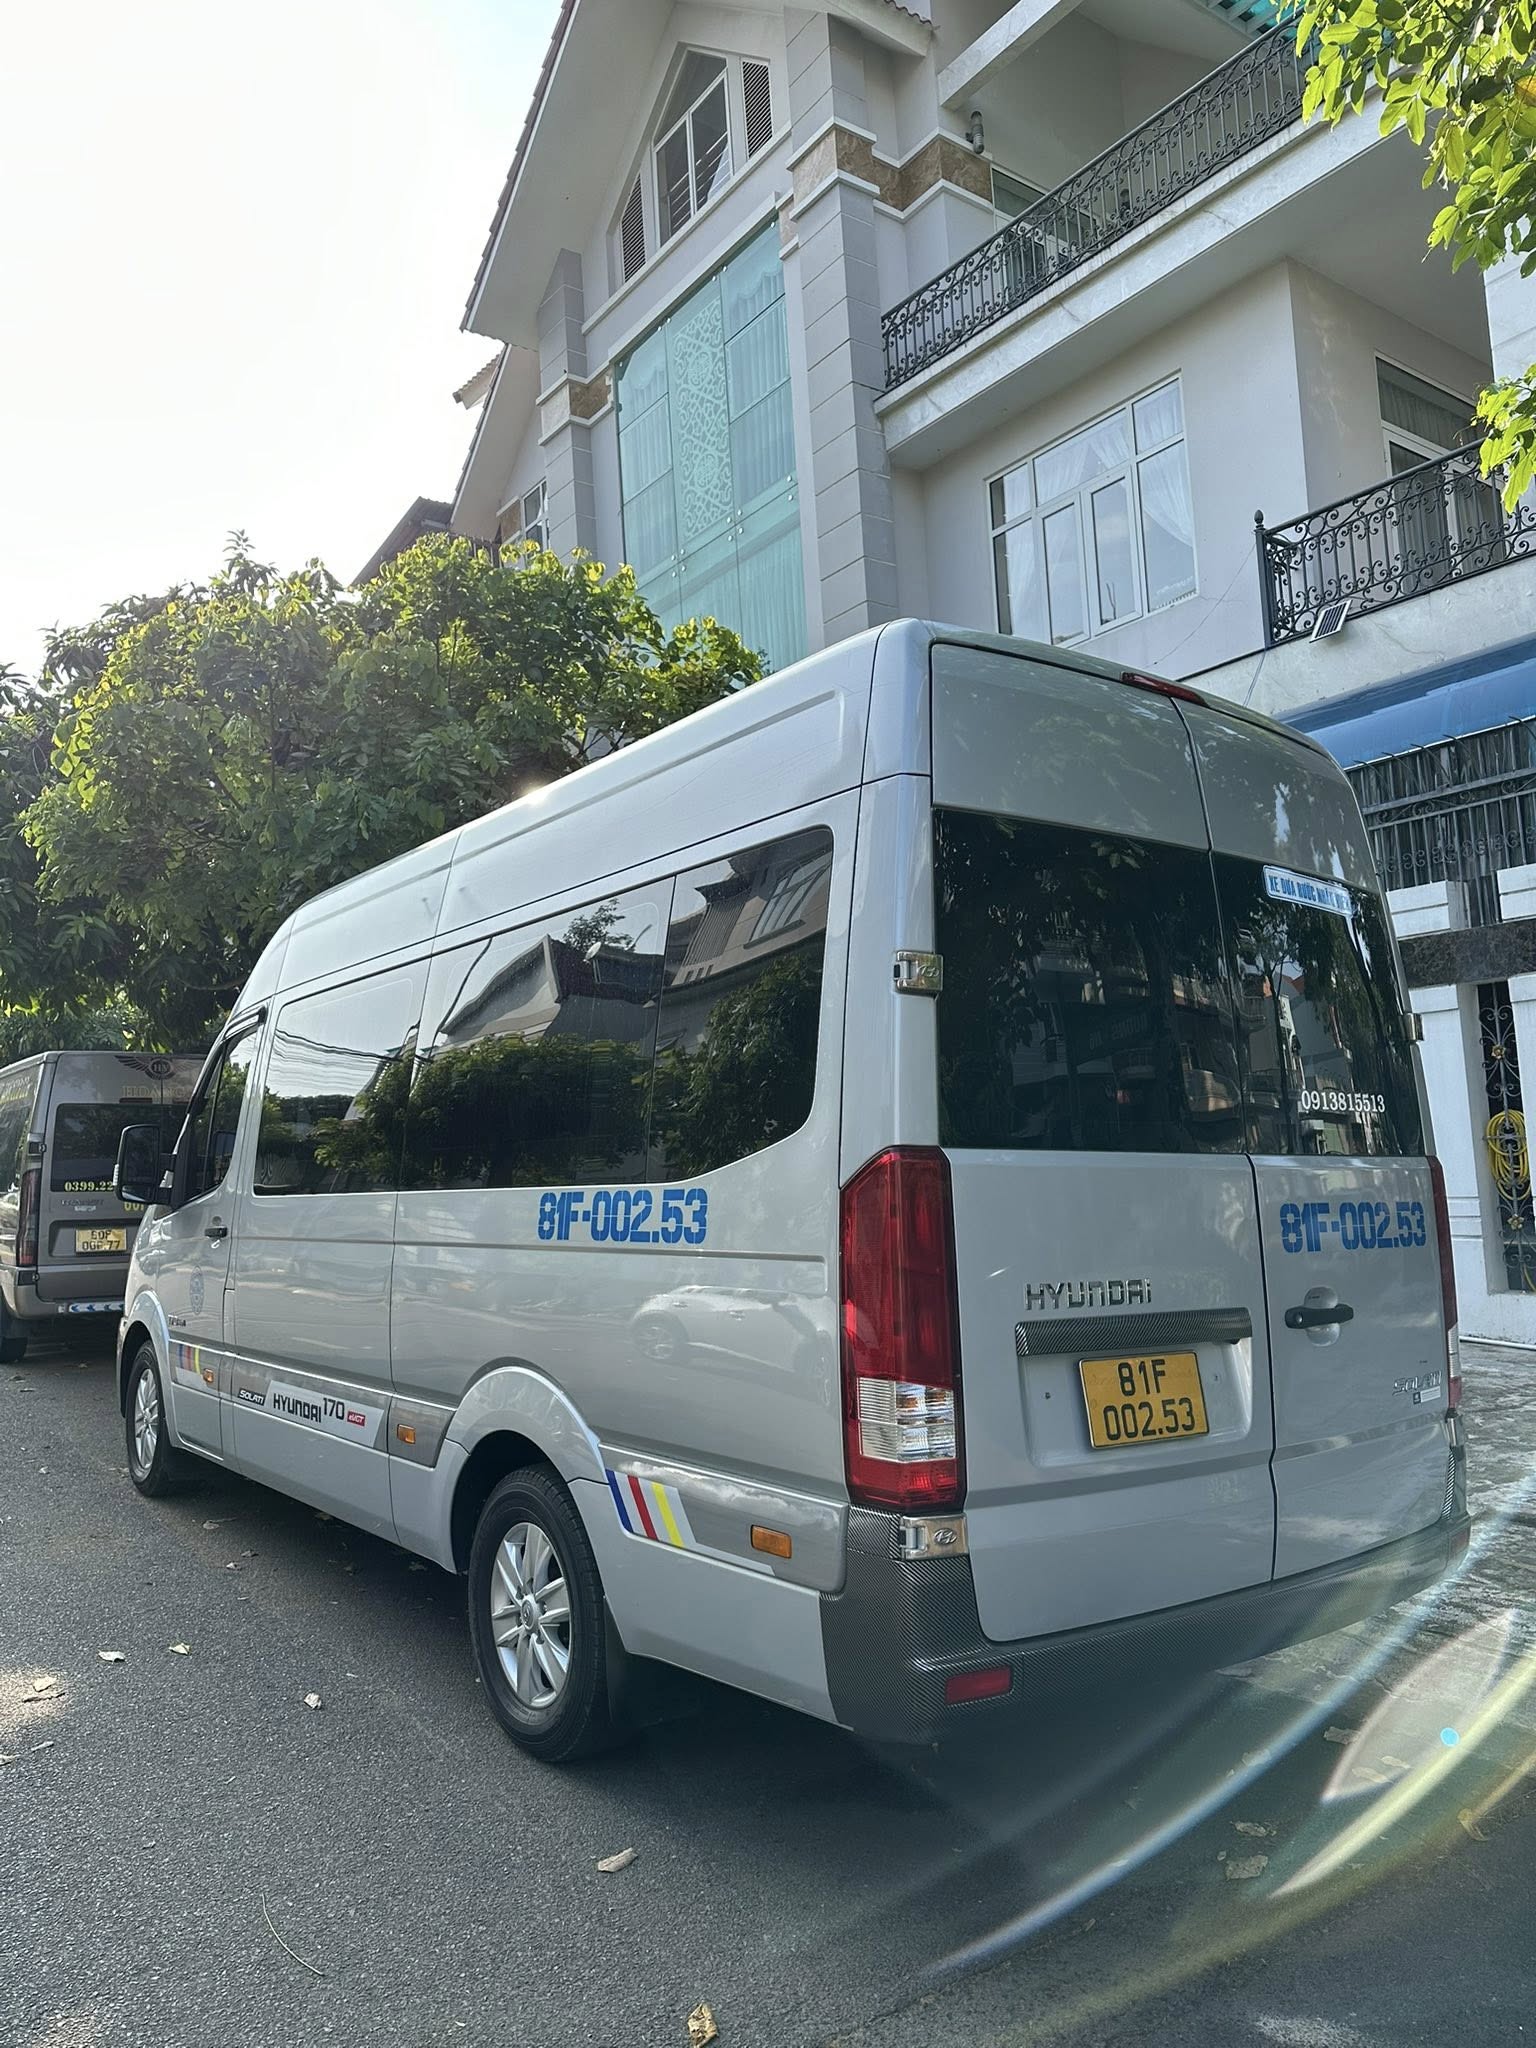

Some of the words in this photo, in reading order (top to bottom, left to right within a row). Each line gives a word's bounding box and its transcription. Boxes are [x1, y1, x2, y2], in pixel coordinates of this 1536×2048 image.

[1268, 875, 1280, 892] XE
[1301, 1090, 1386, 1113] 0913815513
[537, 1187, 708, 1245] 81F-002.53
[1279, 1201, 1427, 1253] 81F-002.53
[1117, 1358, 1166, 1397] 81F
[239, 1389, 265, 1405] SOLATI
[273, 1393, 322, 1423] HYUNDAI
[323, 1397, 345, 1421] 170
[1103, 1397, 1196, 1441] 002.53
